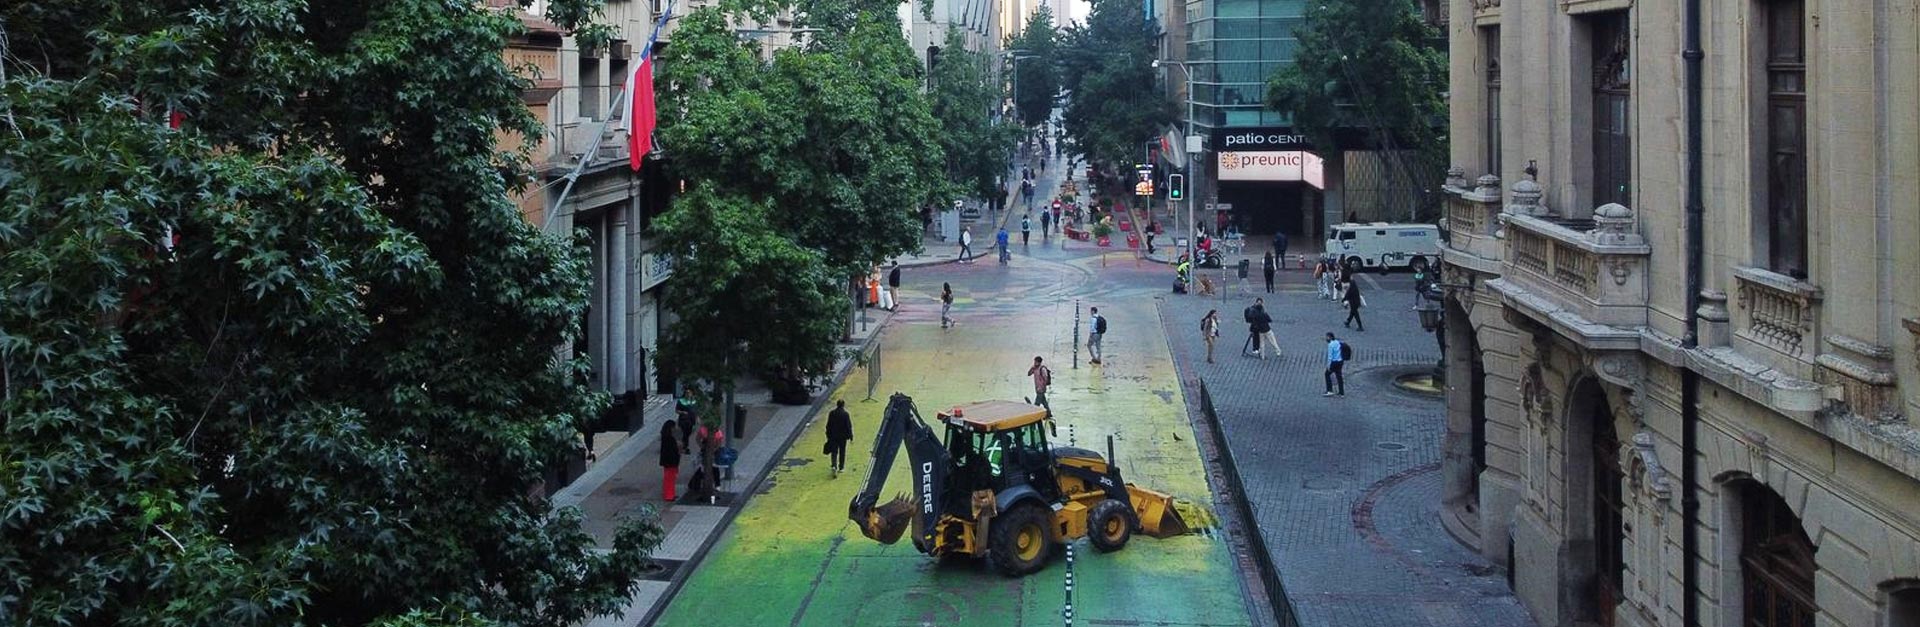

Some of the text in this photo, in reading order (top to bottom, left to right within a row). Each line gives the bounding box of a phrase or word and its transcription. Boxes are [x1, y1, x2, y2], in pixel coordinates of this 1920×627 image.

[1226, 132, 1311, 146] patio CENT
[1241, 153, 1300, 168] preunic
[923, 461, 933, 514] DEERE
